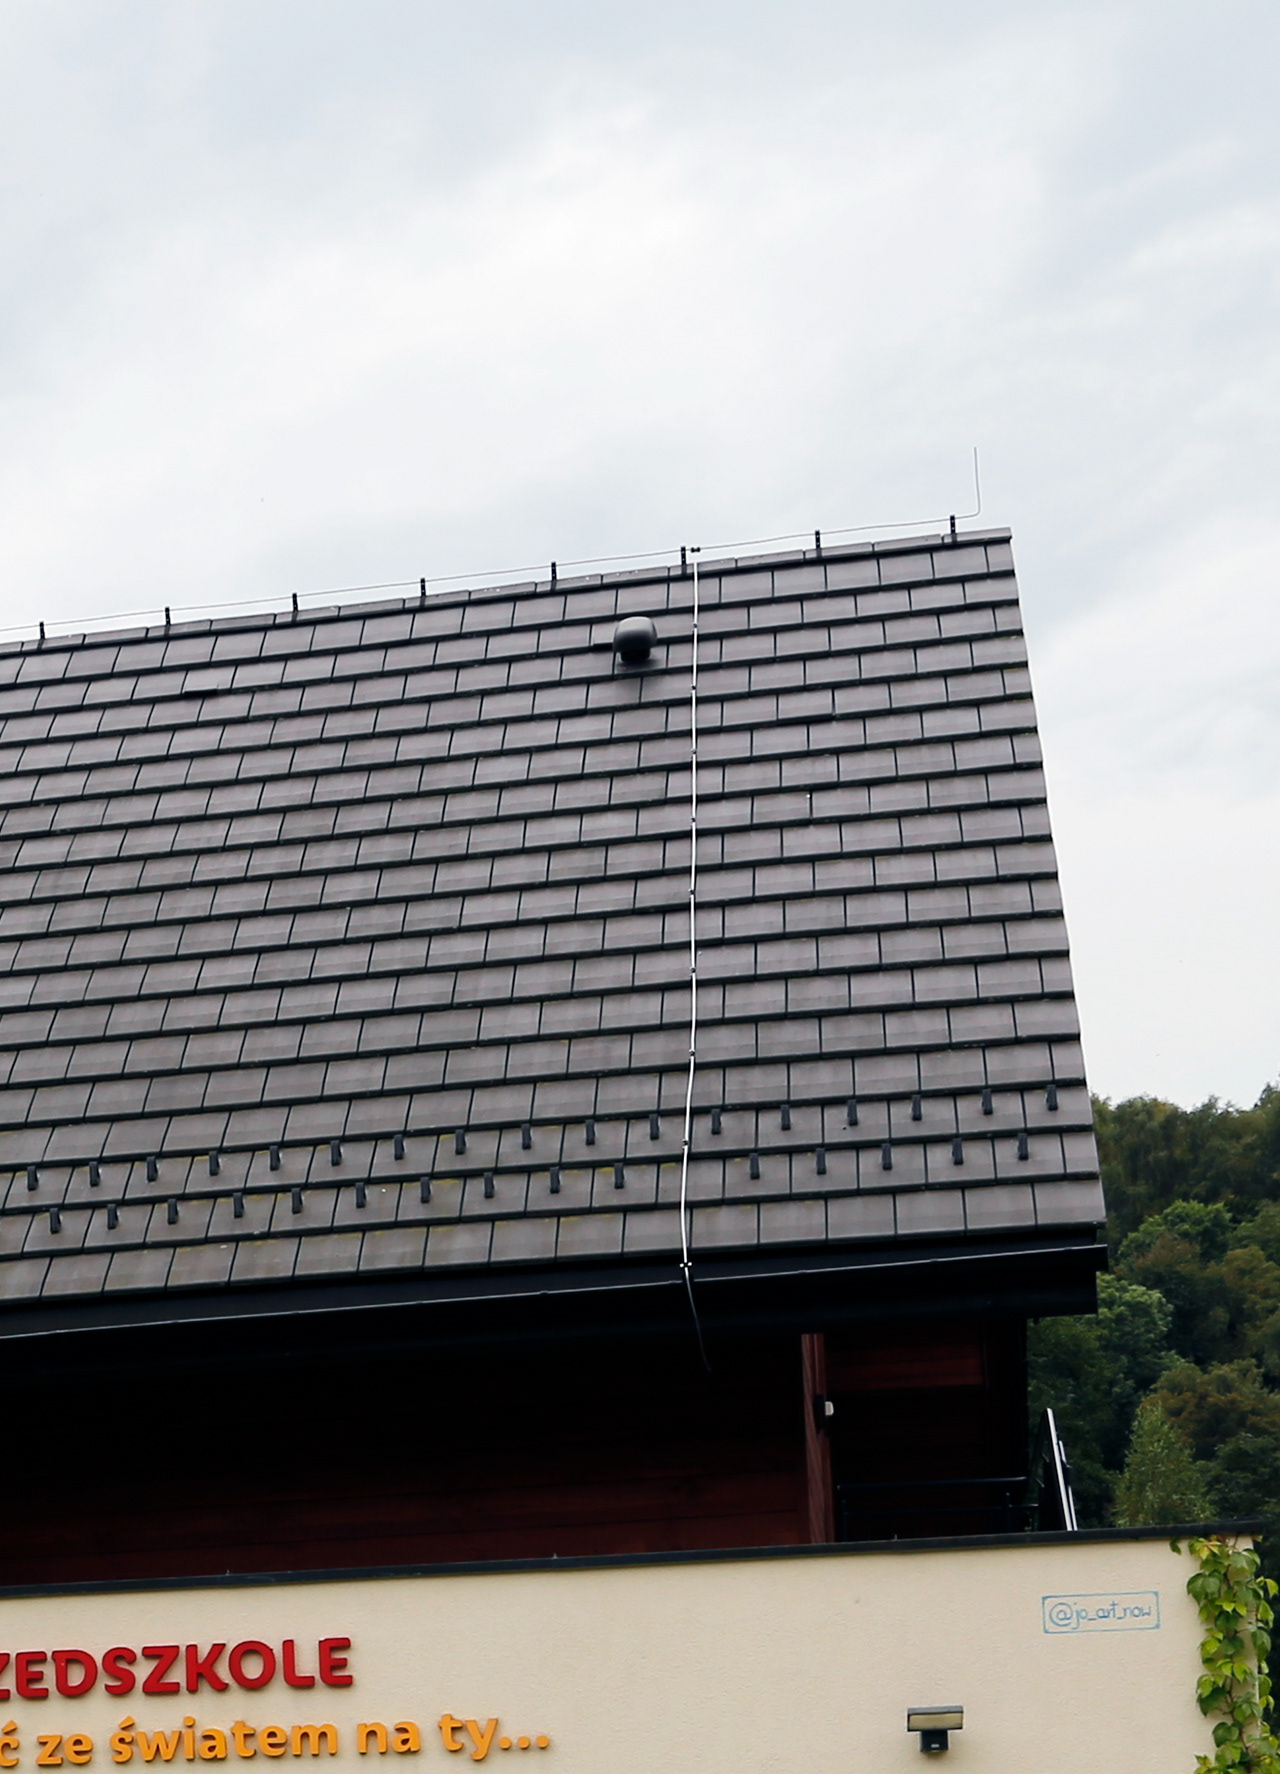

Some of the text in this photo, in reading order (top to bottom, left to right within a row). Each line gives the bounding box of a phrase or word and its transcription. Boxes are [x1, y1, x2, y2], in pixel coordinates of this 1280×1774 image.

[36, 1733, 94, 1765] ze
[110, 1716, 339, 1763] światem
[357, 1721, 422, 1754] na
[438, 1714, 551, 1761] ty...
